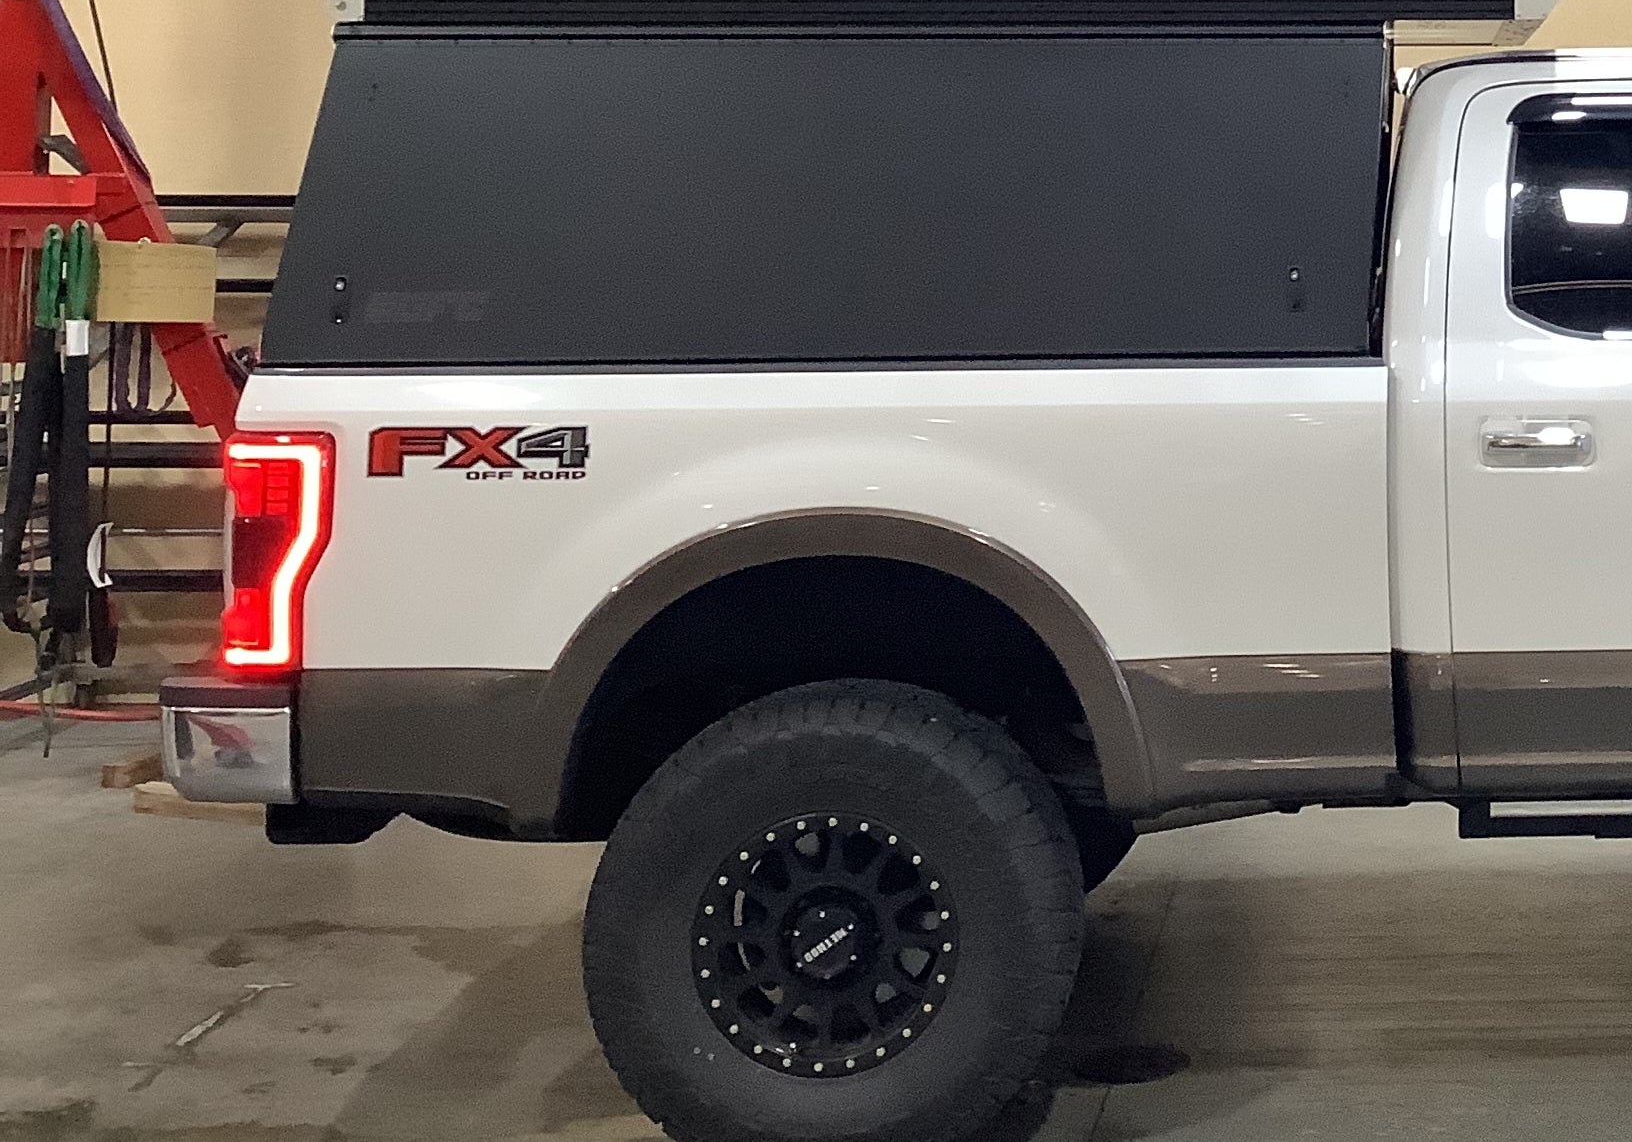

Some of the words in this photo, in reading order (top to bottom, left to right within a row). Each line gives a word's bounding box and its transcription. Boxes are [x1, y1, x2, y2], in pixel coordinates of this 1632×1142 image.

[367, 426, 590, 477] FX4
[466, 470, 513, 481] OFF
[522, 470, 586, 481] ROAD
